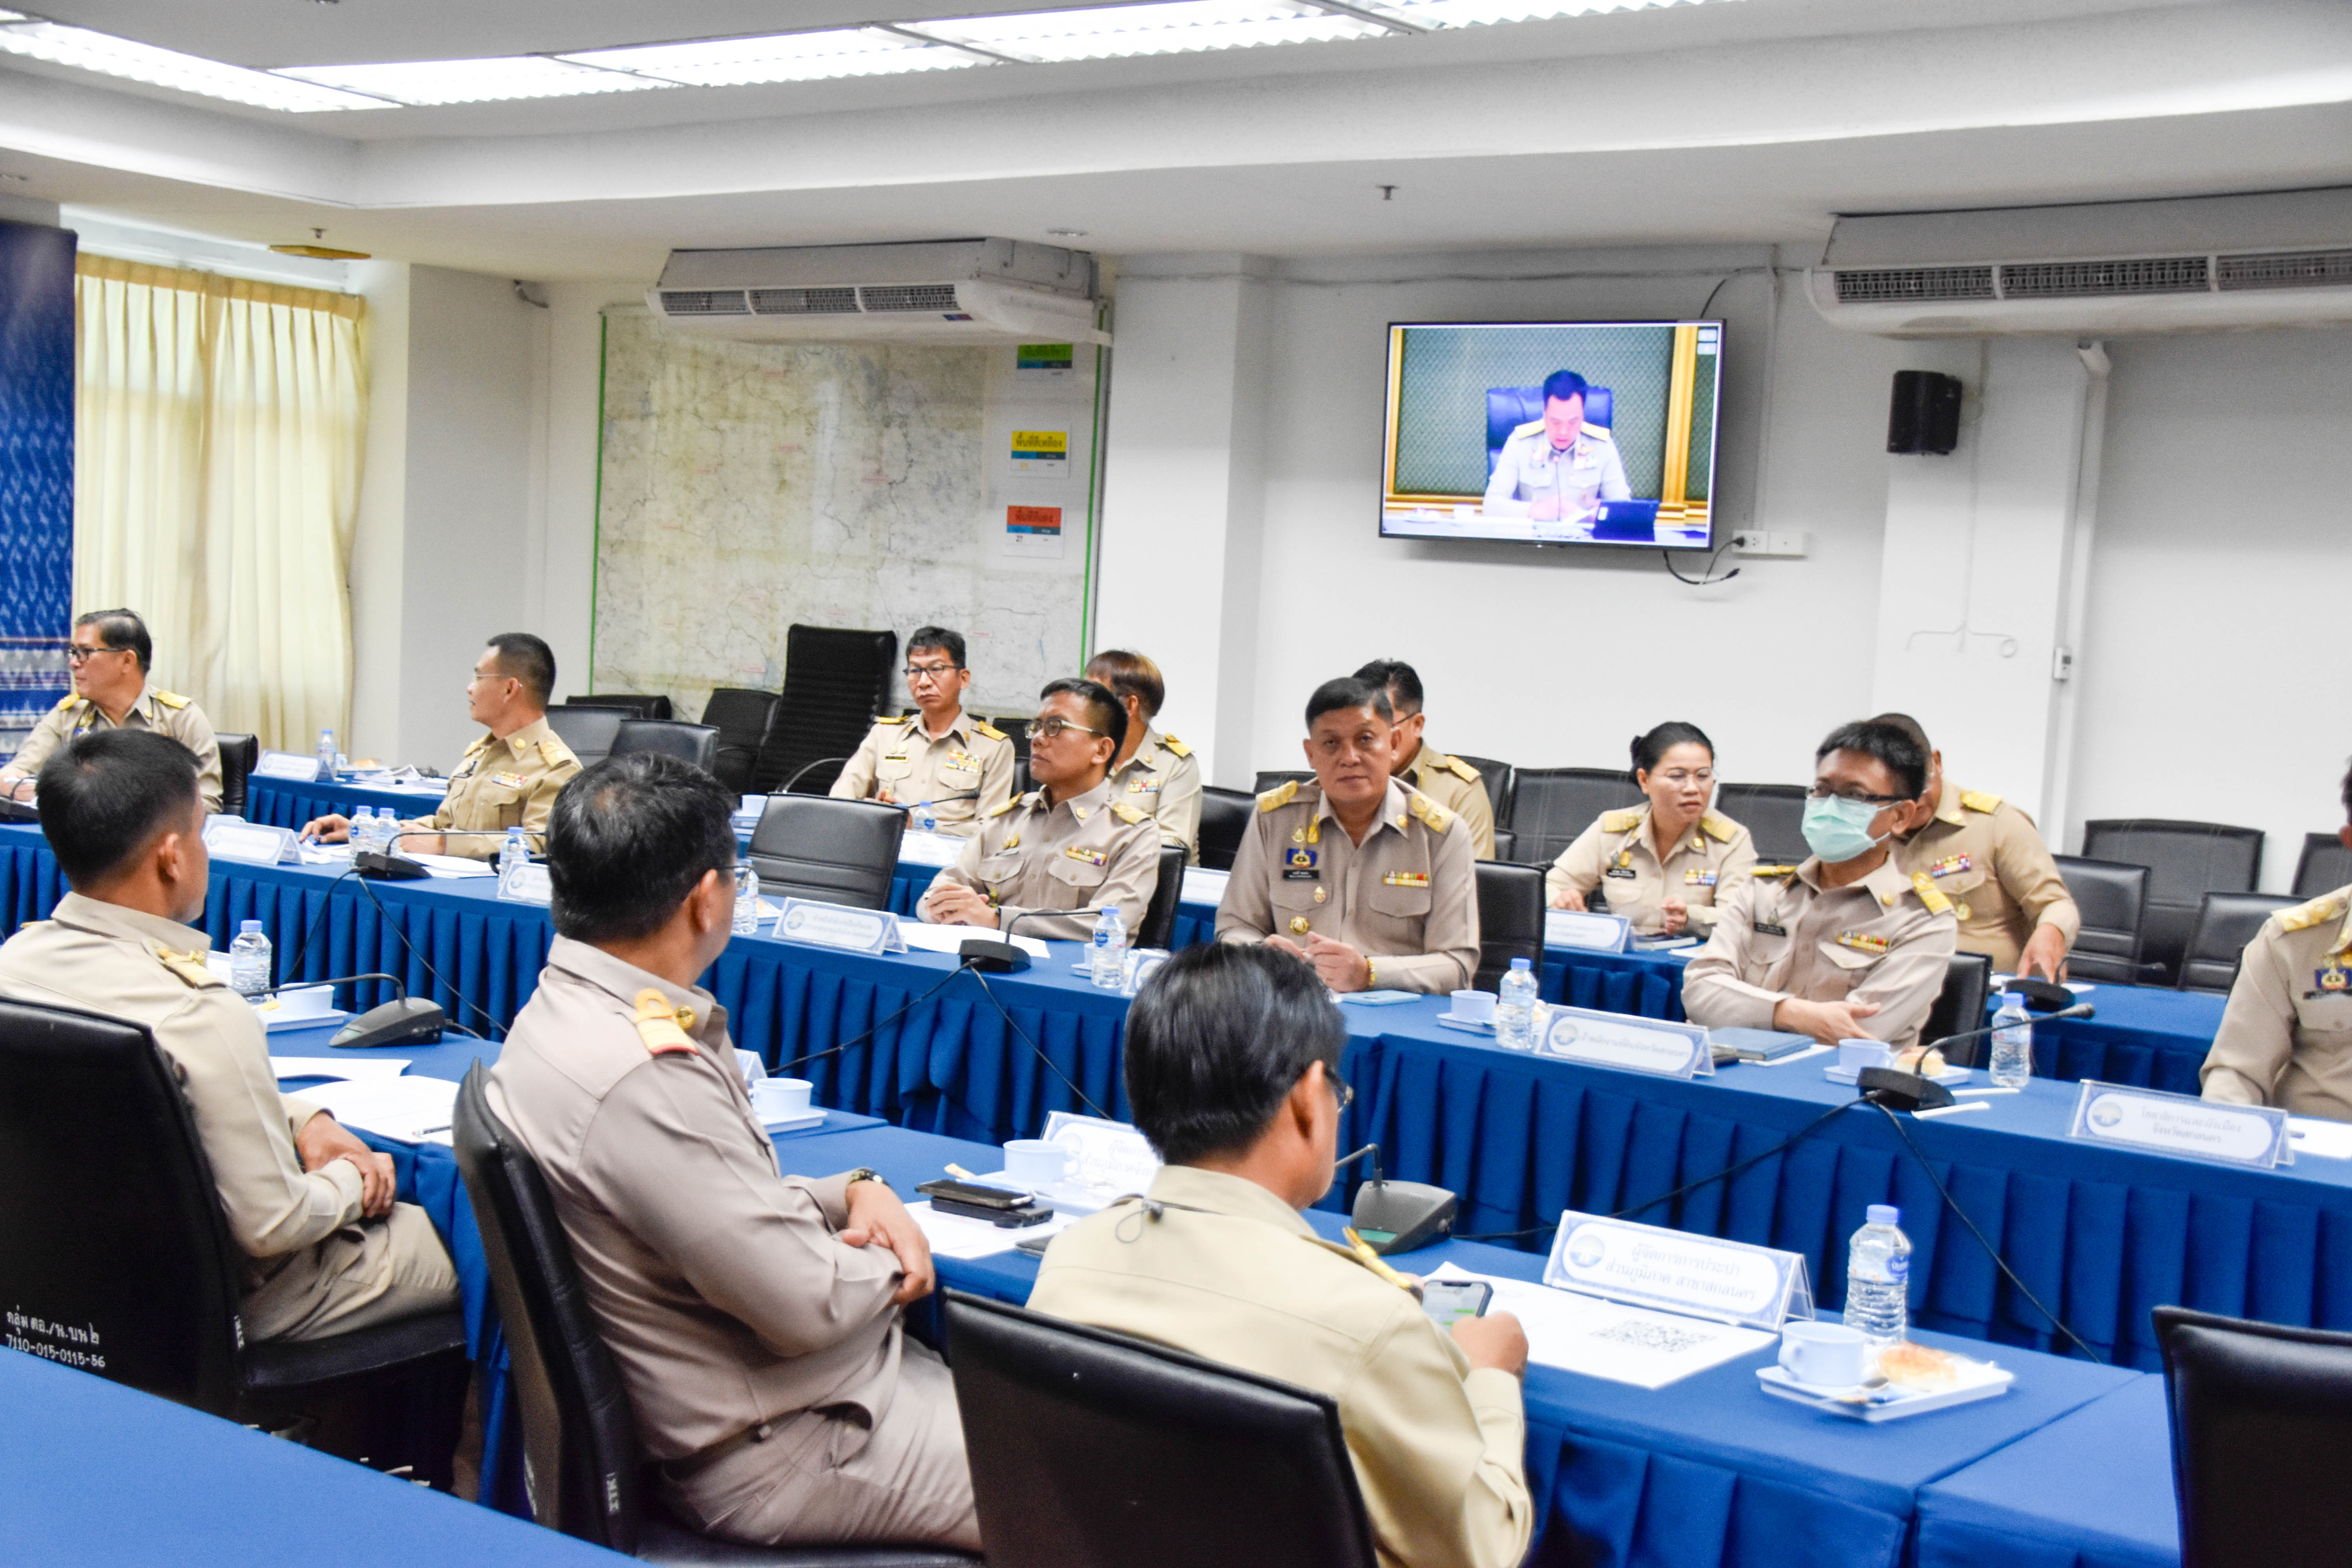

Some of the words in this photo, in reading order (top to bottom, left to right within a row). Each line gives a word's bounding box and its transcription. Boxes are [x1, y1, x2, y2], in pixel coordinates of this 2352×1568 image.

[2152, 1122, 2222, 1143] จังหวัดสกลนคร
[1631, 1241, 1741, 1276] ผู้จัดการการประปา
[1605, 1258, 1671, 1283] ส่วนภูมิภาค
[1675, 1275, 1757, 1301] สาขาสกลนคร
[5, 1333, 106, 1368] 7110-015-0115-56
